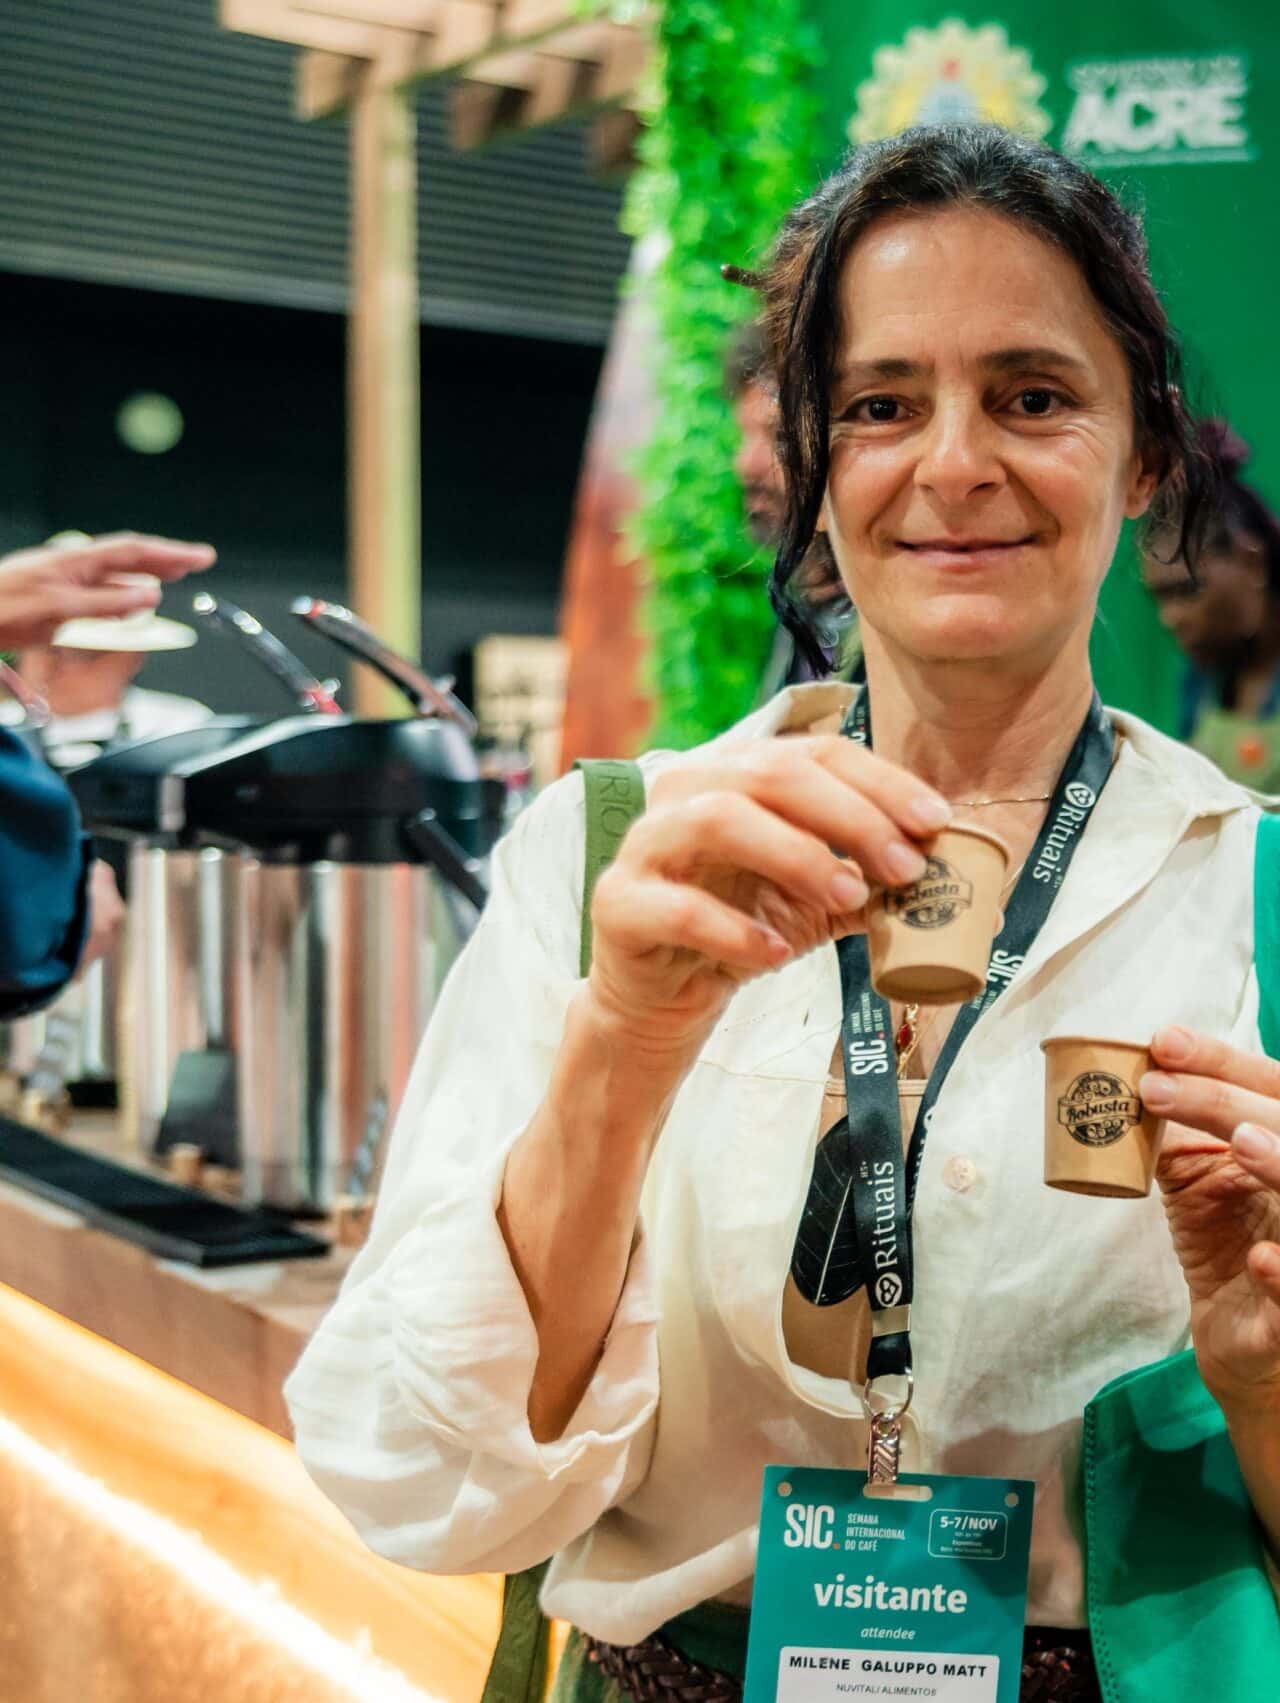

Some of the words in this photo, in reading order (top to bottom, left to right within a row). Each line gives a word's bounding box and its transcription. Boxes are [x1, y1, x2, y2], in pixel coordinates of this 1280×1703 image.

[1061, 85, 1248, 153] ACRE
[1032, 802, 1087, 883] Rituais
[1067, 1099, 1130, 1123] Robusta
[867, 1160, 898, 1269] Rituais
[847, 1512, 879, 1524] SEMANA
[940, 1515, 998, 1531] 5-7/NOV
[846, 1526, 905, 1540] INTERNACIONAL
[858, 1539, 879, 1552] CAFÉ
[814, 1573, 968, 1613] visitante
[860, 1626, 916, 1640] attendee
[790, 1655, 851, 1671] MILENE
[861, 1659, 937, 1676] GALUPPO
[943, 1663, 988, 1678] MATT
